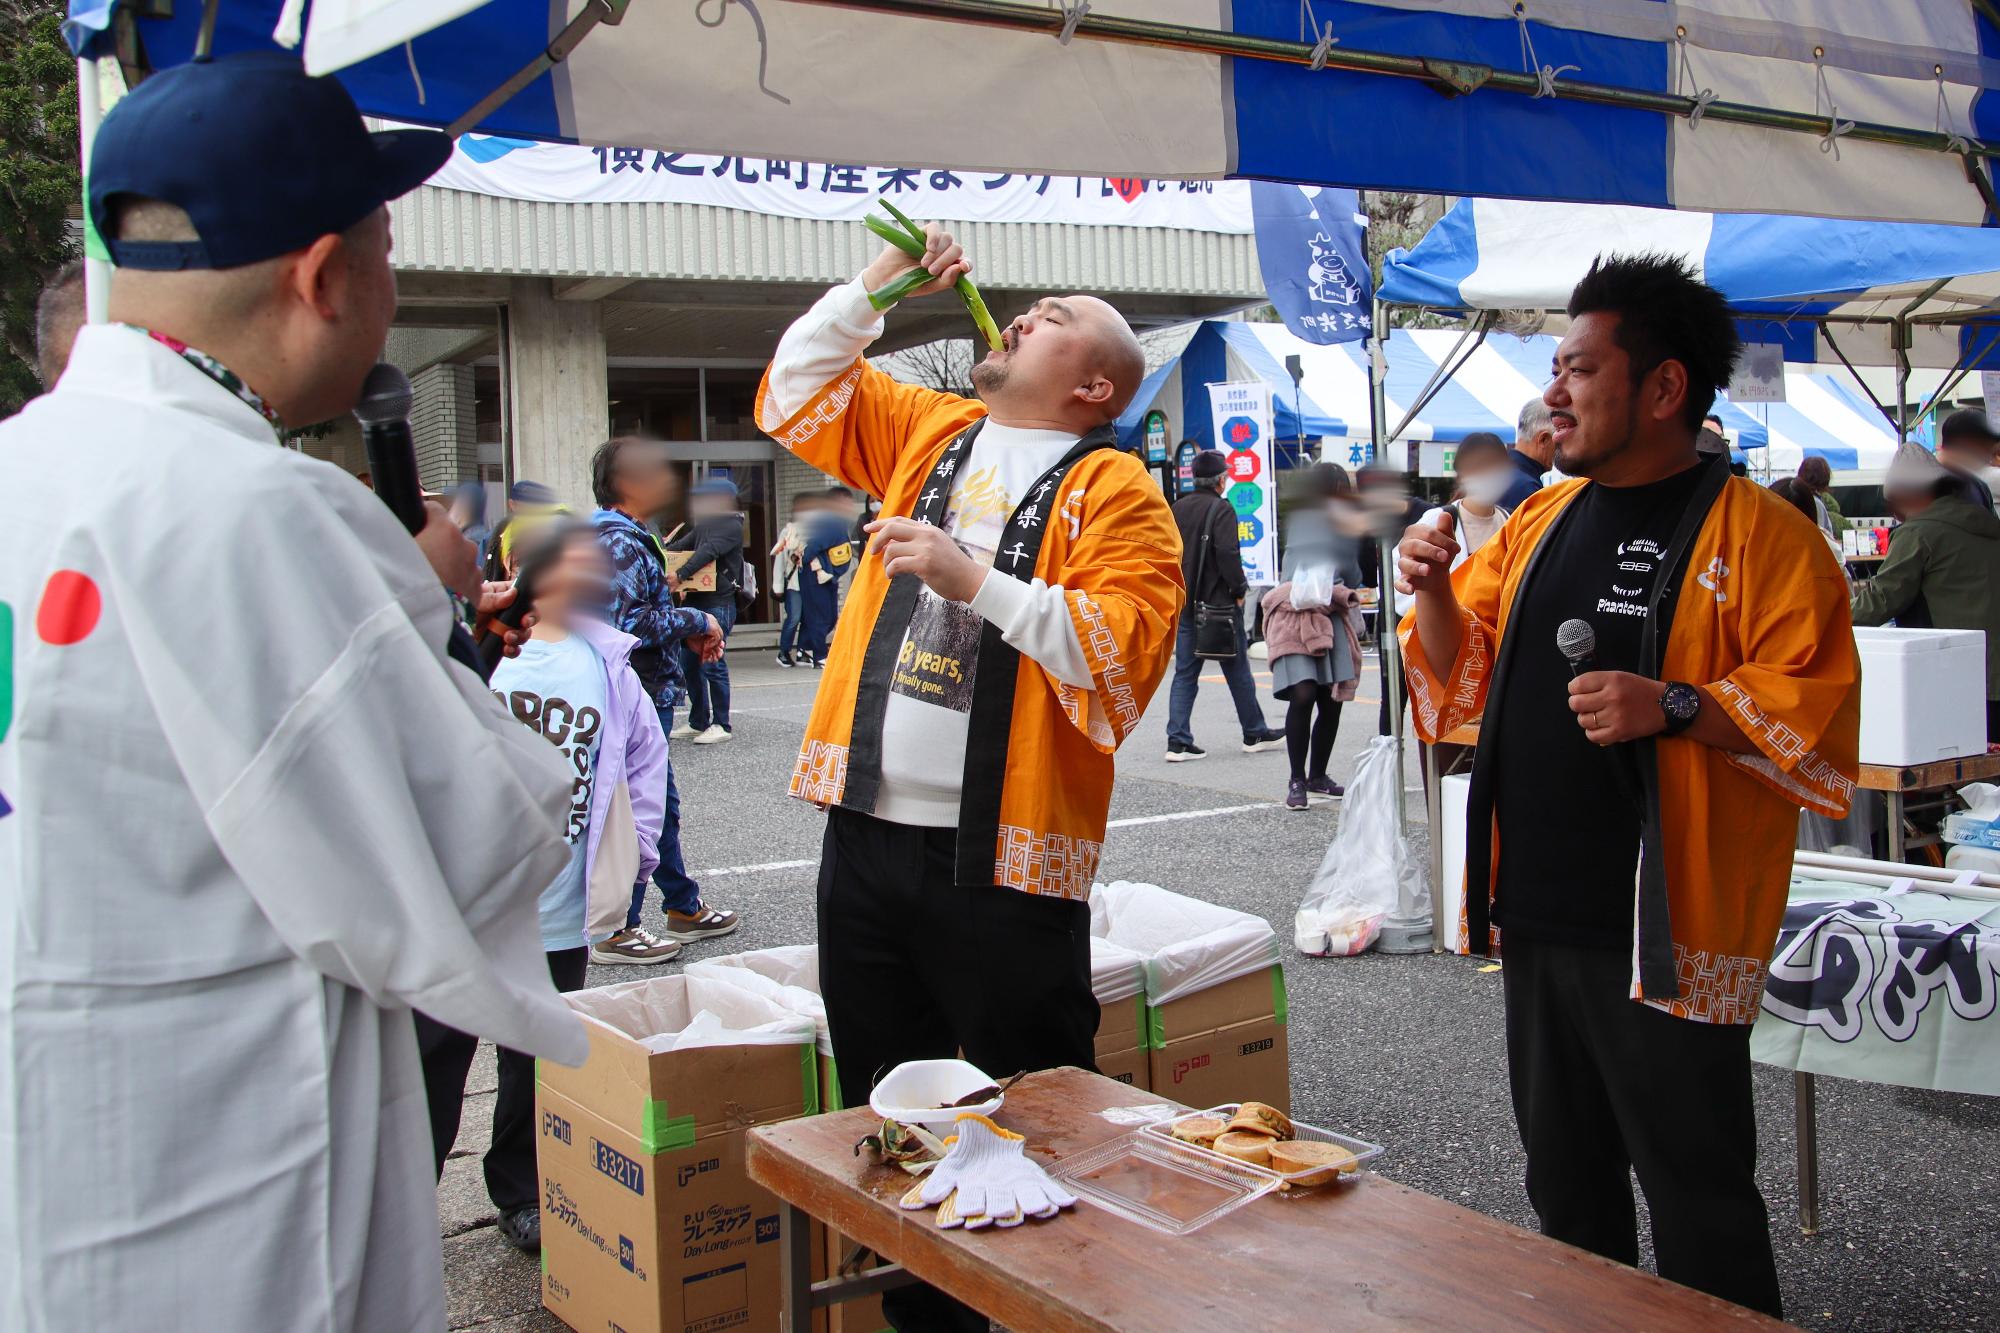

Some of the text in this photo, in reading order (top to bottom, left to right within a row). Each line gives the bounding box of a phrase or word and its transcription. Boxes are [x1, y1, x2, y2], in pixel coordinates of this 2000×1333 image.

[911, 650, 965, 684] years,
[922, 682, 944, 695] gone.
[600, 1146, 640, 1190] 33217
